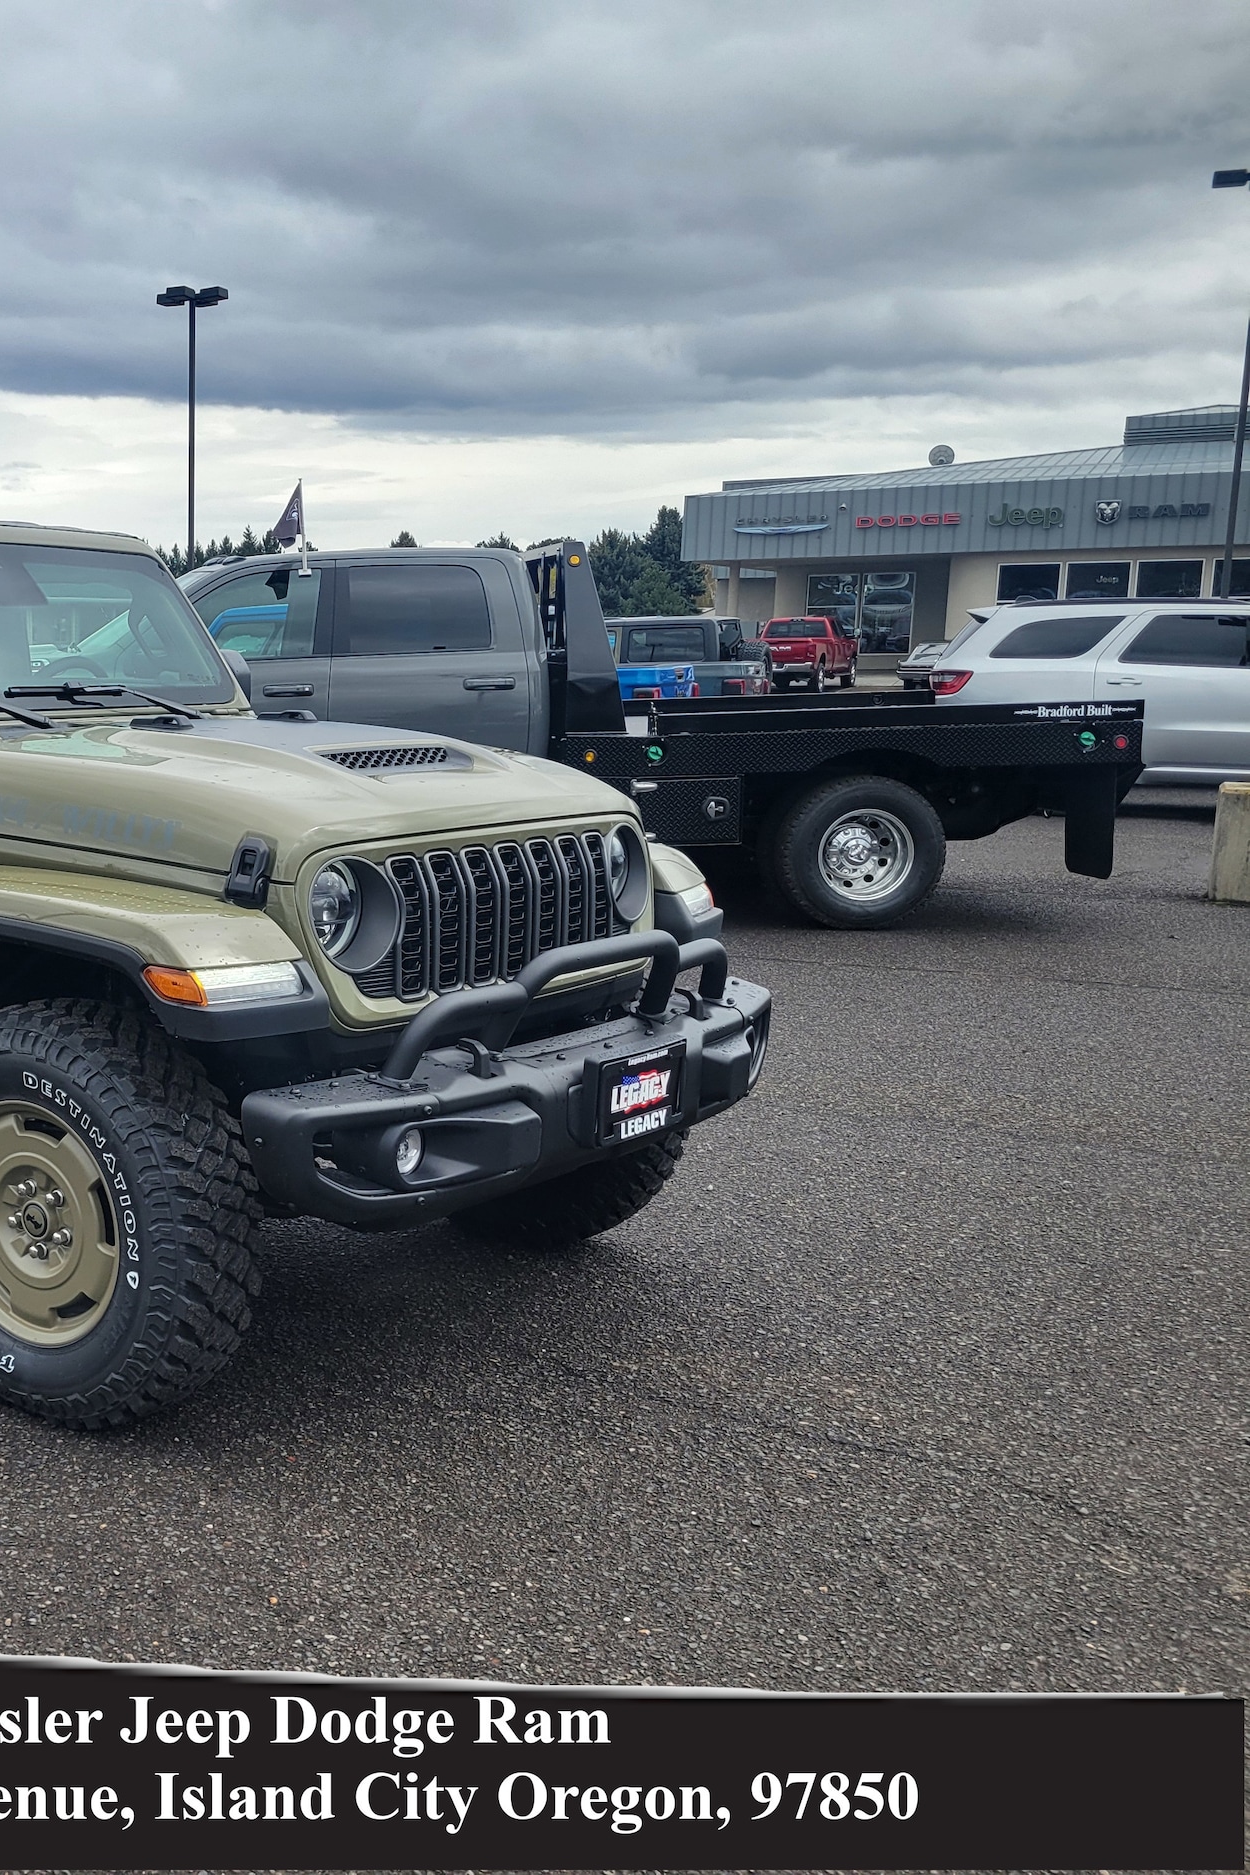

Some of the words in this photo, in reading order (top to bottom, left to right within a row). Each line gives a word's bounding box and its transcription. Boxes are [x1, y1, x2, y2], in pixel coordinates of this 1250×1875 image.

[987, 502, 1065, 529] Jeep
[1128, 502, 1211, 519] RAM
[735, 514, 829, 526] CHRYSLER
[855, 512, 962, 528] DODGE
[1095, 575, 1120, 585] Jeep
[1036, 704, 1085, 718] Bradford
[1086, 704, 1113, 717] Built
[611, 1072, 670, 1112] LEGACY
[620, 1108, 668, 1140] LEGACY
[23, 1071, 141, 1262] DESTINATION
